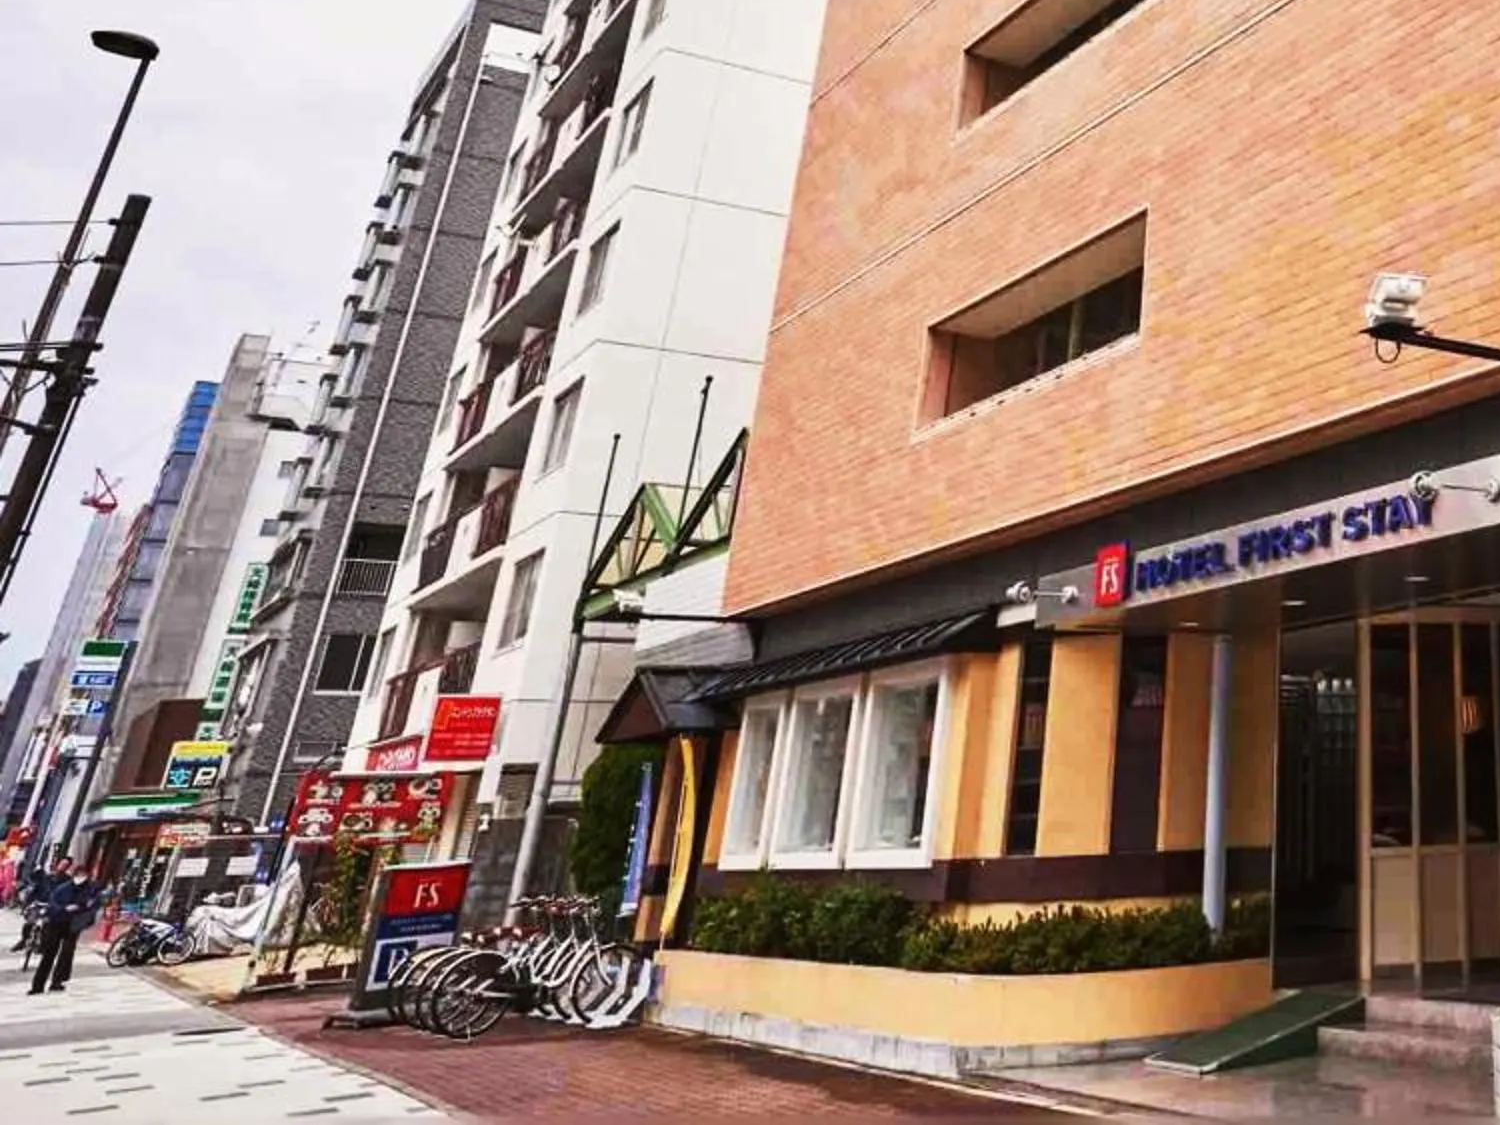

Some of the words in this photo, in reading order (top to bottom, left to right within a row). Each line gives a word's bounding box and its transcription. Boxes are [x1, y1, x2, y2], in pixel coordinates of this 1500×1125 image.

[1135, 542, 1235, 592] HOTEL
[1237, 513, 1336, 567] FIRST
[1342, 490, 1441, 542] STAY
